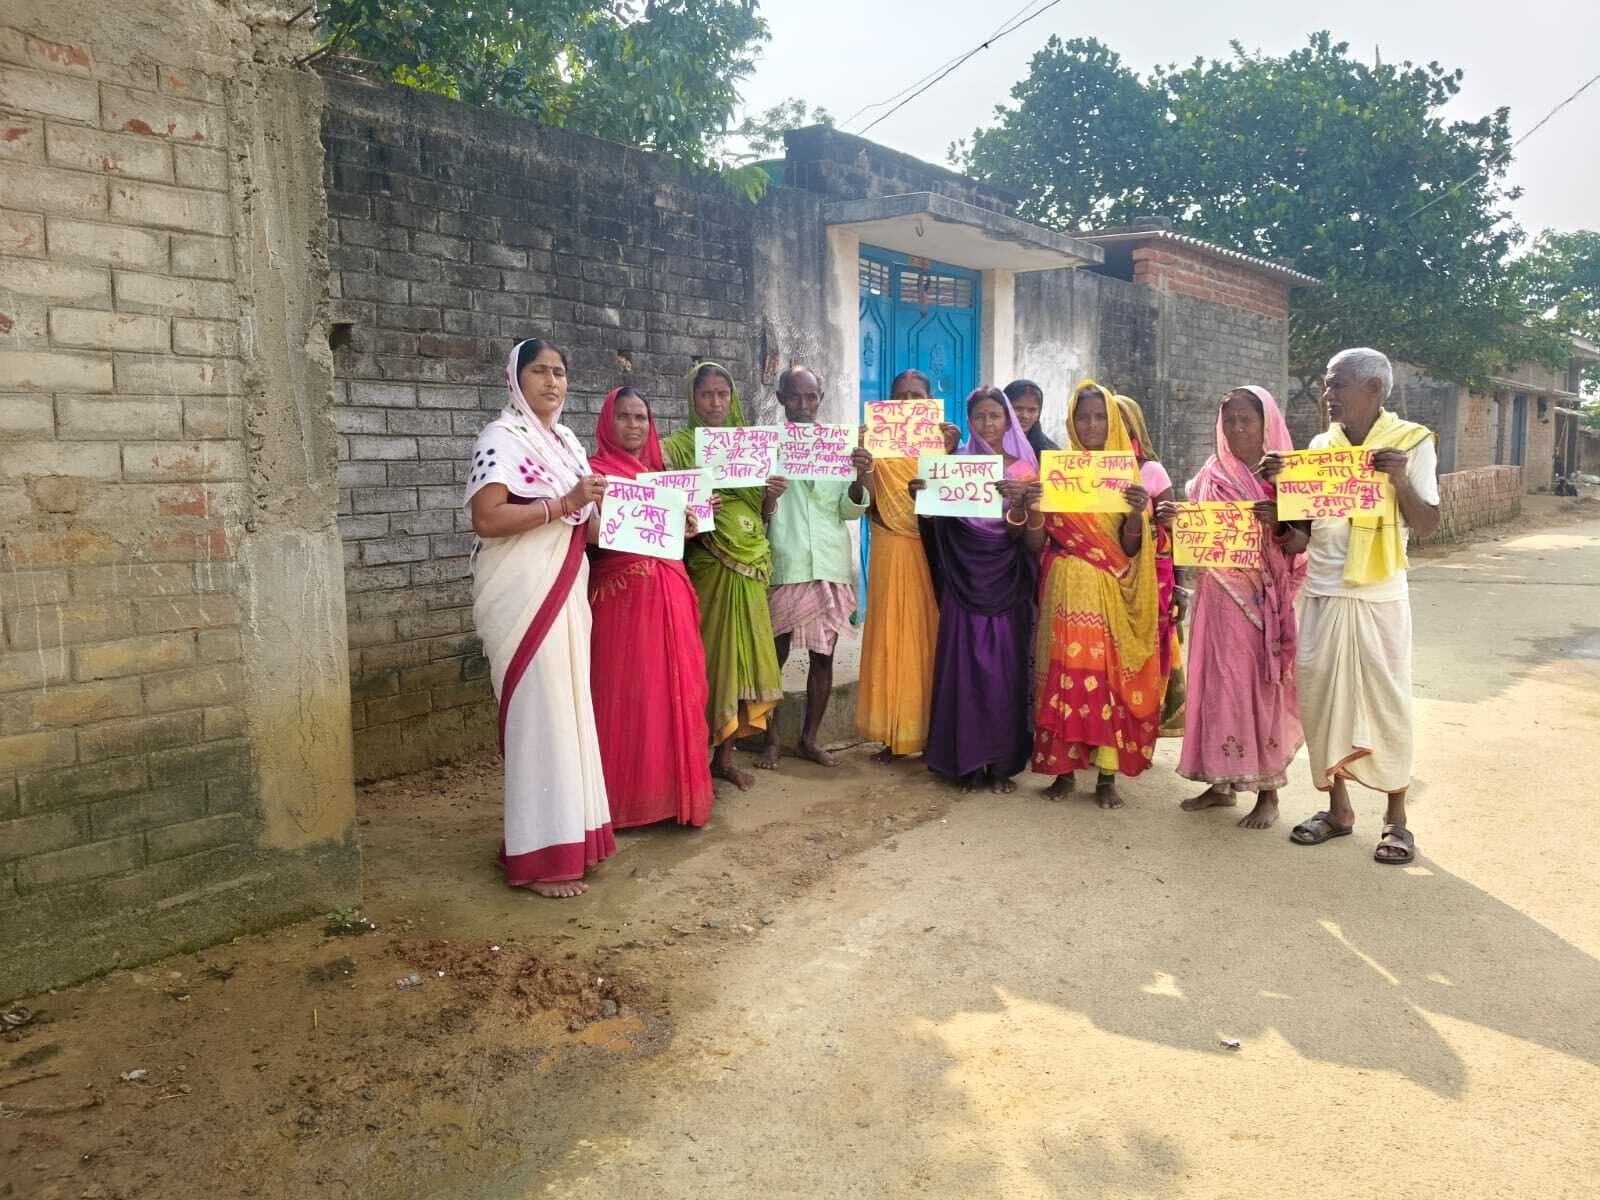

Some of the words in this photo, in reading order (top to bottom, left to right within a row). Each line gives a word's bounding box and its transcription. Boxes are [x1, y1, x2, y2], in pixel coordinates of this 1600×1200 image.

[928, 462, 949, 479] 11
[607, 482, 656, 501] मतदान
[939, 482, 998, 503] 2025
[1302, 509, 1347, 518] 2025
